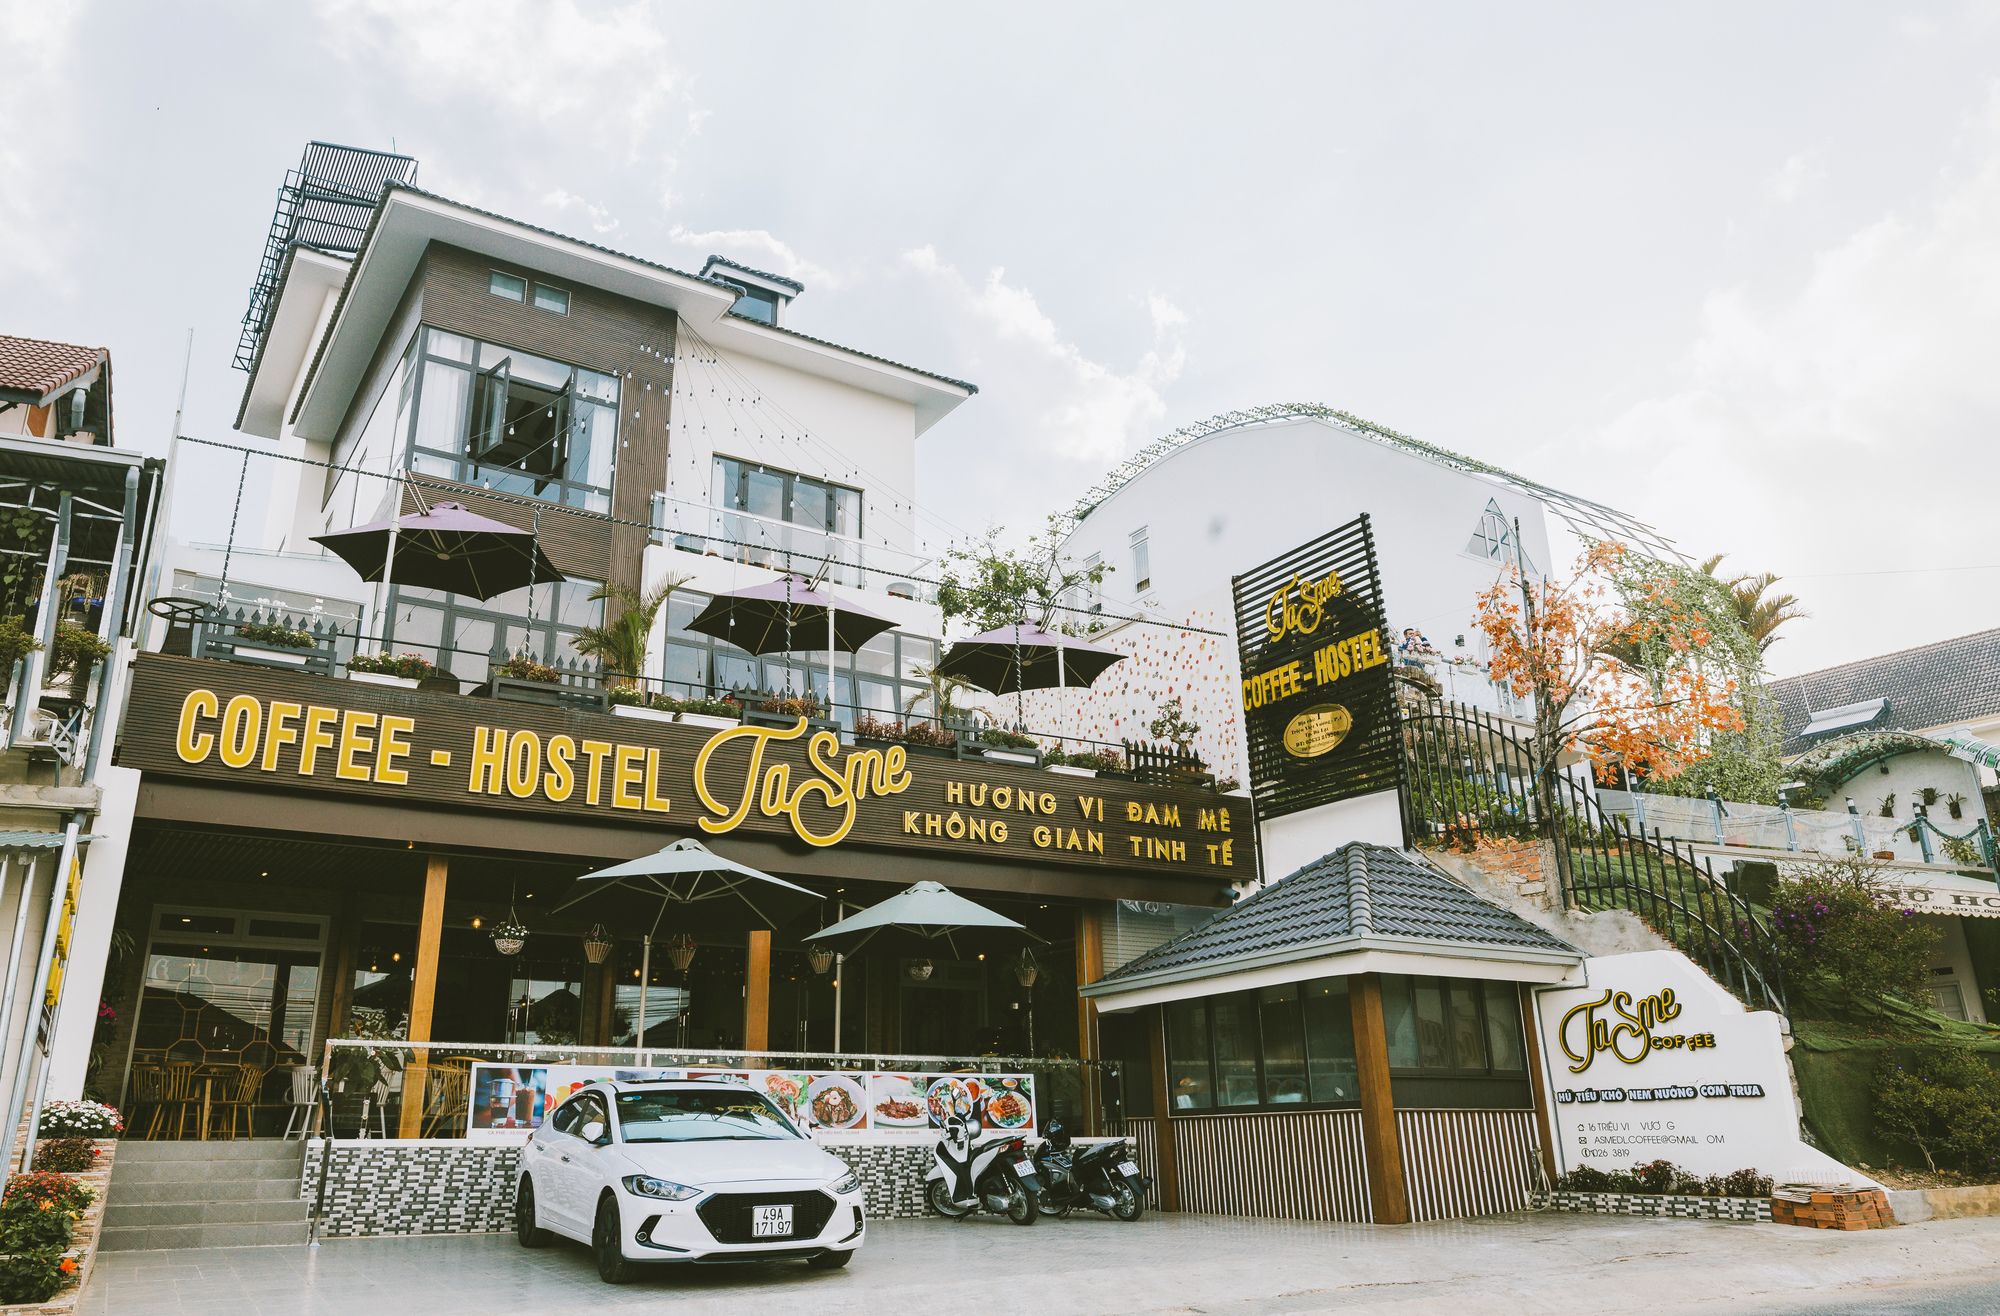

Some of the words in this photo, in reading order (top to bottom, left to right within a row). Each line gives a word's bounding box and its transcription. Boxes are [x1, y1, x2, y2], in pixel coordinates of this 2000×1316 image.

[1242, 660, 1301, 711] COFFEE
[1314, 628, 1388, 686] HOSTEL
[176, 689, 415, 786] COFFEE
[430, 749, 451, 767] -
[468, 726, 671, 813] HOSTEL
[693, 715, 912, 847] TaSme
[947, 781, 1056, 815] HƯƠNG
[1126, 802, 1182, 828] ĐAM
[902, 811, 1008, 843] KHÔNG
[1034, 826, 1104, 855] GIAN
[1130, 836, 1186, 862] TINH
[1206, 838, 1234, 866] TẾ
[1558, 988, 1682, 1074] TaSme
[1650, 1032, 1716, 1052] COFFEE
[1628, 1088, 1652, 1100] NEM
[755, 1221, 791, 1235] 171.97
[762, 1208, 784, 1220] 49A
